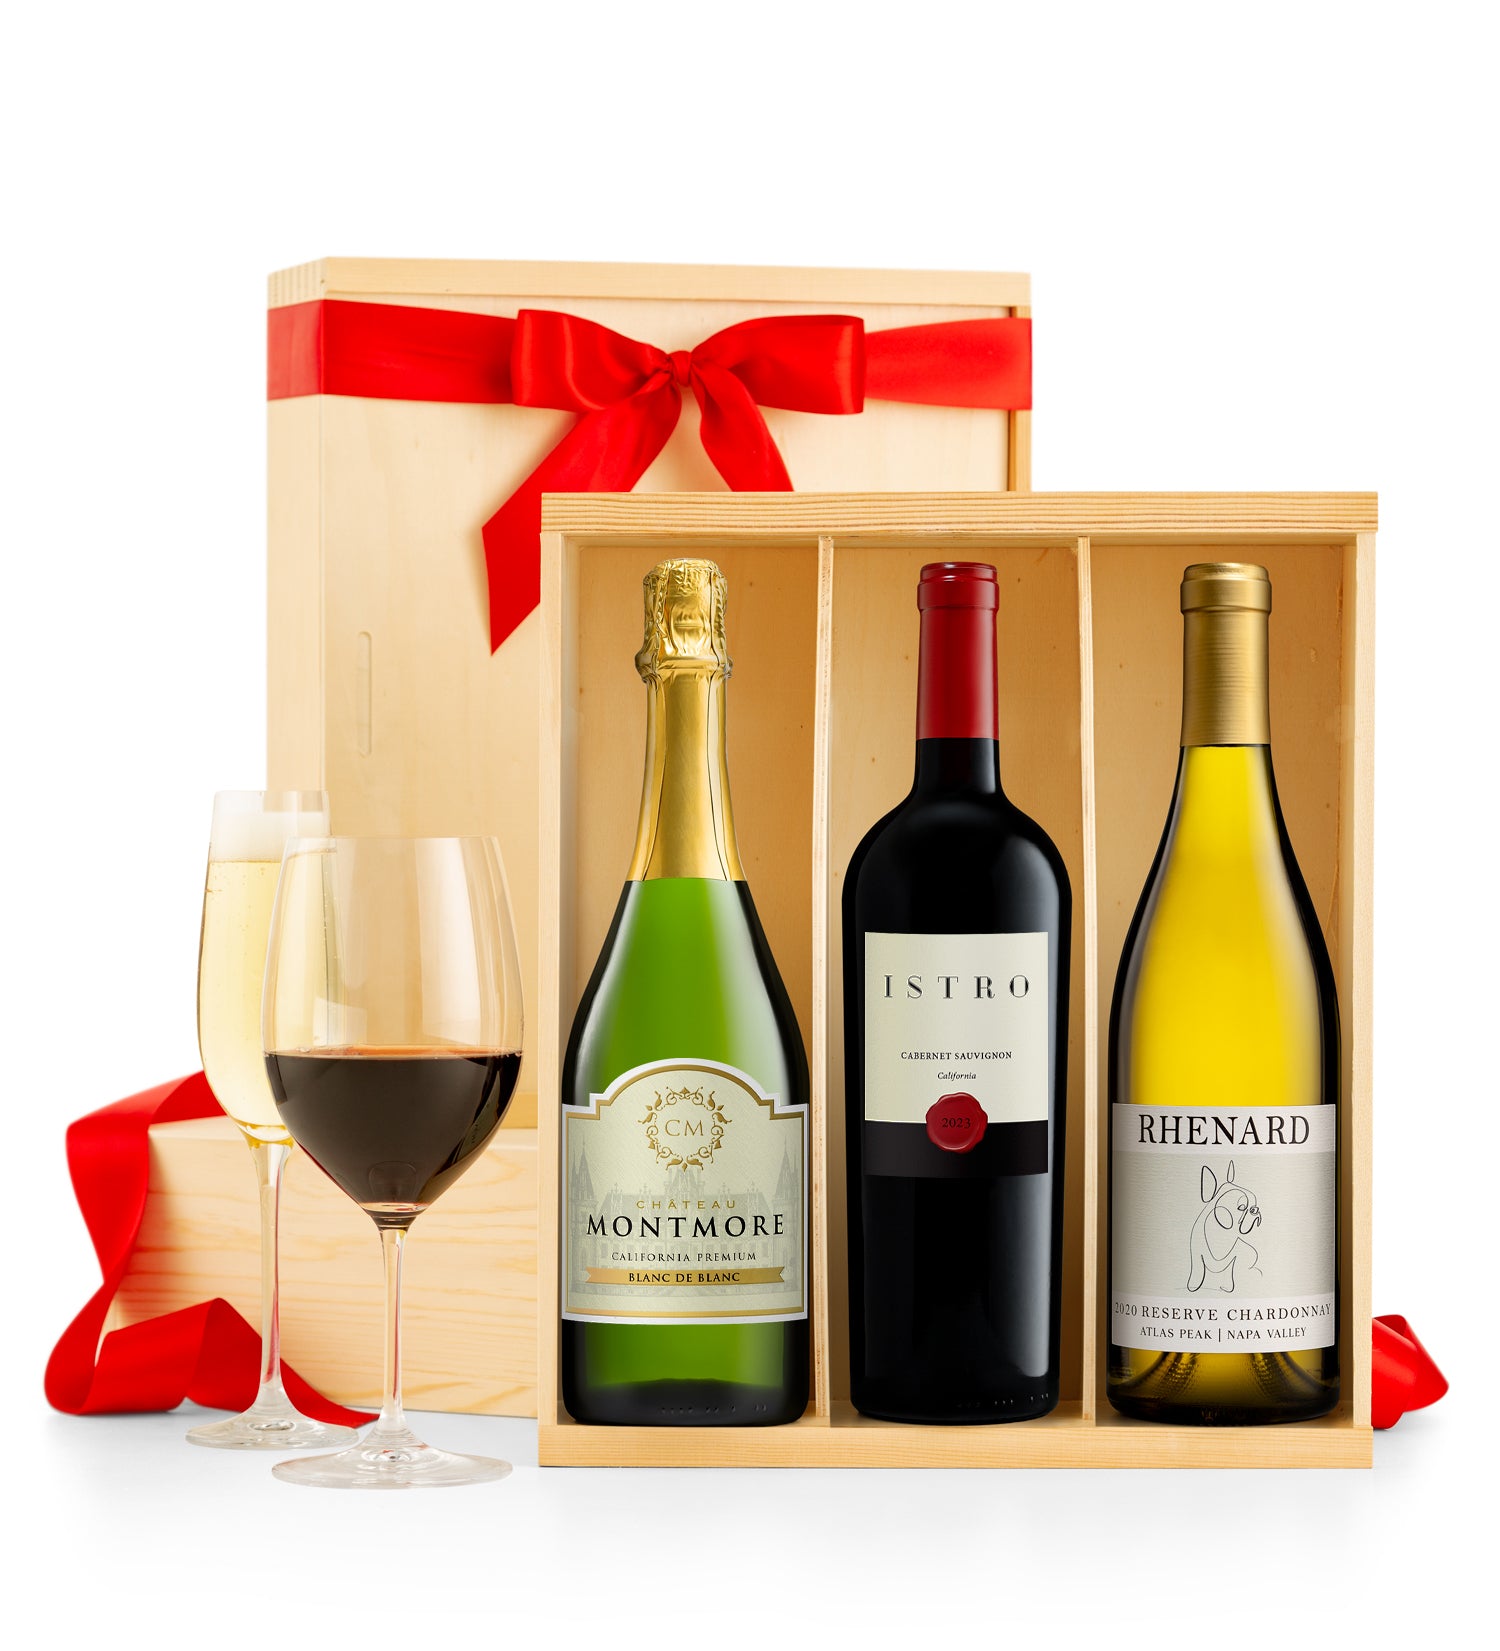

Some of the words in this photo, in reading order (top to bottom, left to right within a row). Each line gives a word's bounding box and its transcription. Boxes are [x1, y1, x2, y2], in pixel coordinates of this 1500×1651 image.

[883, 974, 1030, 999] ISTRO
[900, 1051, 952, 1060] CABERNET
[954, 1051, 1013, 1060] SAUVIGNON
[937, 1071, 977, 1081] California
[665, 1119, 704, 1137] CM
[941, 1117, 971, 1129] 2023
[1138, 1114, 1310, 1145] RHENARD
[636, 1199, 736, 1209] CHÂTEAU
[586, 1213, 784, 1238] MONTMORE
[611, 1251, 691, 1262] CALIFORNIA
[697, 1251, 757, 1262] PREMIUM
[628, 1272, 671, 1283] BLANC
[675, 1273, 693, 1283] DE
[698, 1272, 740, 1283] BLANC
[1114, 1301, 1138, 1317] 2020
[1141, 1305, 1218, 1321] RESERVE
[1226, 1302, 1332, 1321] CHARDONNAY
[1139, 1326, 1174, 1339] ATLAS
[1179, 1328, 1213, 1340] PEAK
[1227, 1328, 1261, 1340] NAPA
[1267, 1326, 1307, 1339] VALLEY
